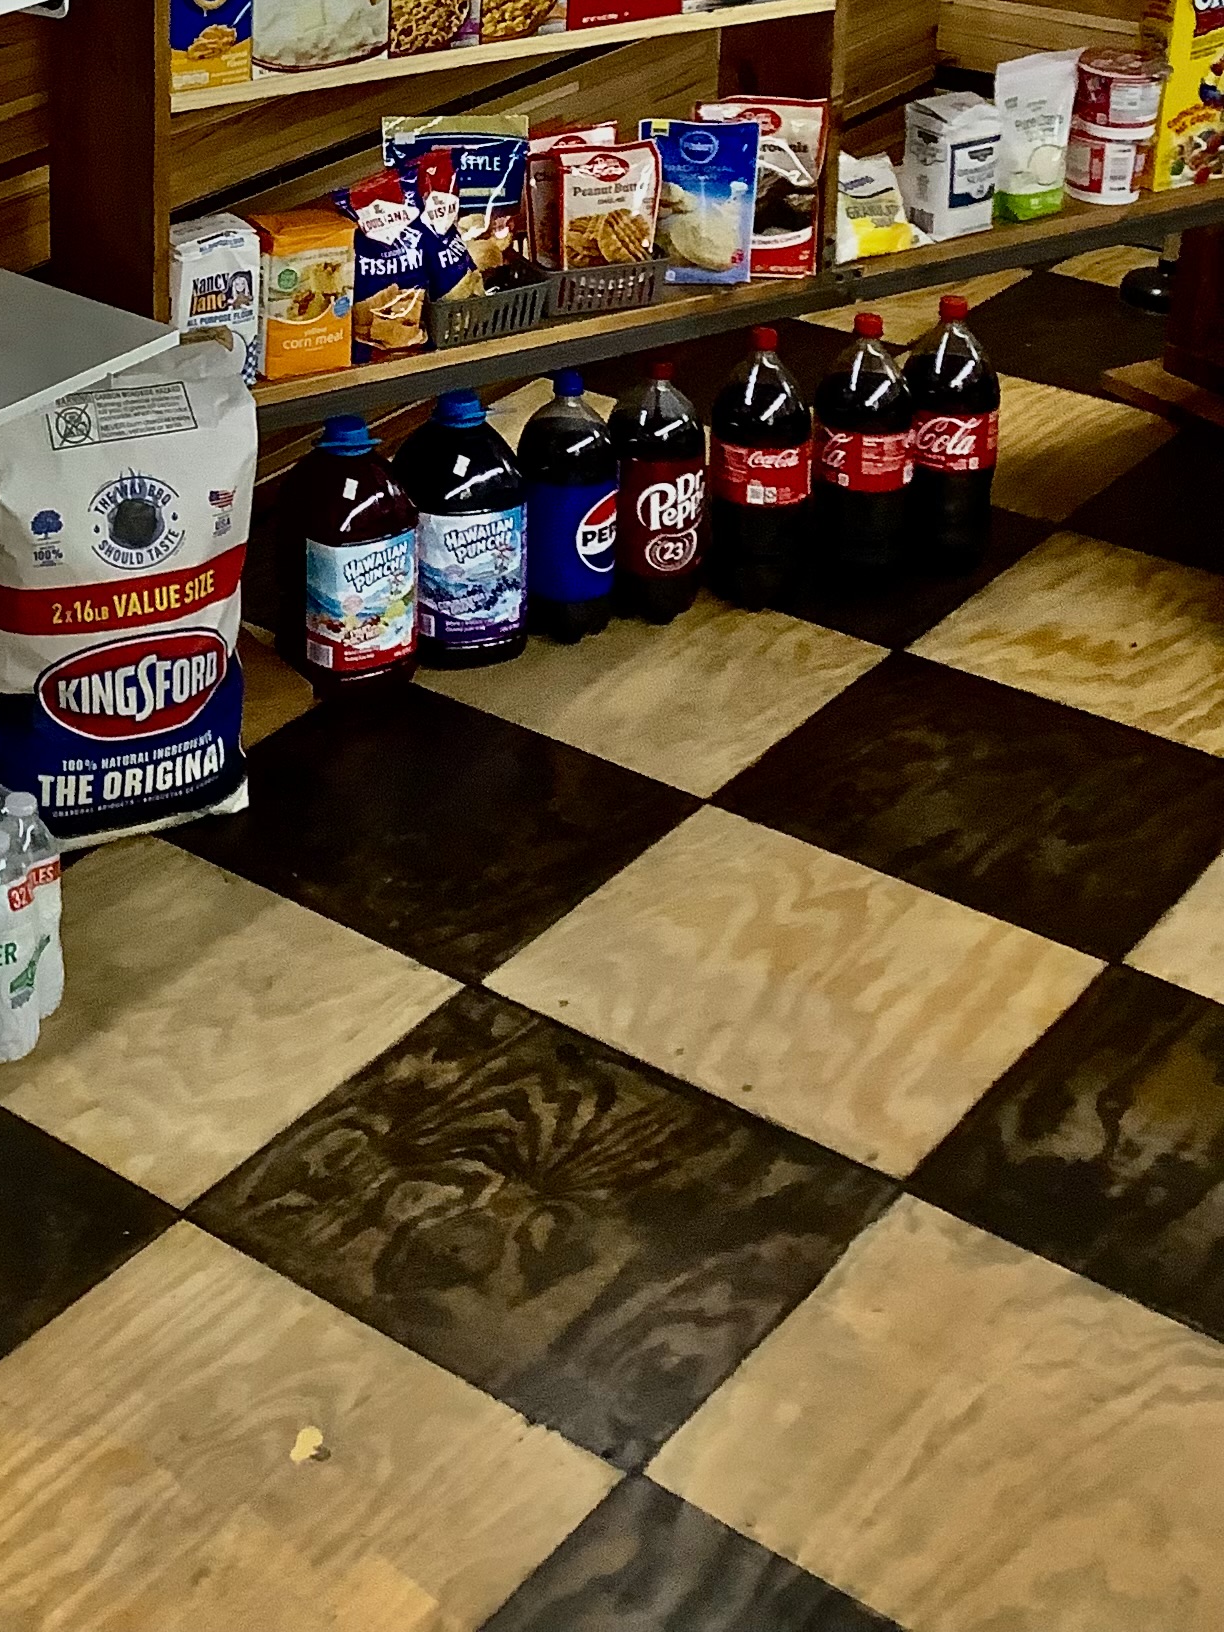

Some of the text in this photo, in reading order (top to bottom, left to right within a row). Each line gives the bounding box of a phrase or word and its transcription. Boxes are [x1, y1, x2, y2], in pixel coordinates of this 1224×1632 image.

[460, 151, 502, 172] STYLE
[573, 185, 612, 197] Peanut
[359, 255, 398, 275] FISH
[192, 273, 230, 296] Nancy
[192, 291, 227, 315] Jane
[282, 328, 344, 351] corn meal
[916, 417, 983, 455] Cola
[93, 493, 116, 515] THE
[147, 484, 173, 506] BBQ
[444, 517, 514, 551] HAWAIIAN
[33, 548, 64, 561] 100%
[98, 528, 181, 565] SHOULD TASTE
[663, 541, 684, 560] 23
[344, 541, 408, 582] HAWAIIAN
[112, 584, 181, 618] VALUE
[184, 569, 215, 604] SIZE
[58, 651, 218, 722] KINGSFORD
[62, 758, 98, 772] 100%
[101, 751, 150, 770] NATURAL
[38, 774, 94, 807] THE
[10, 886, 28, 909] 32
